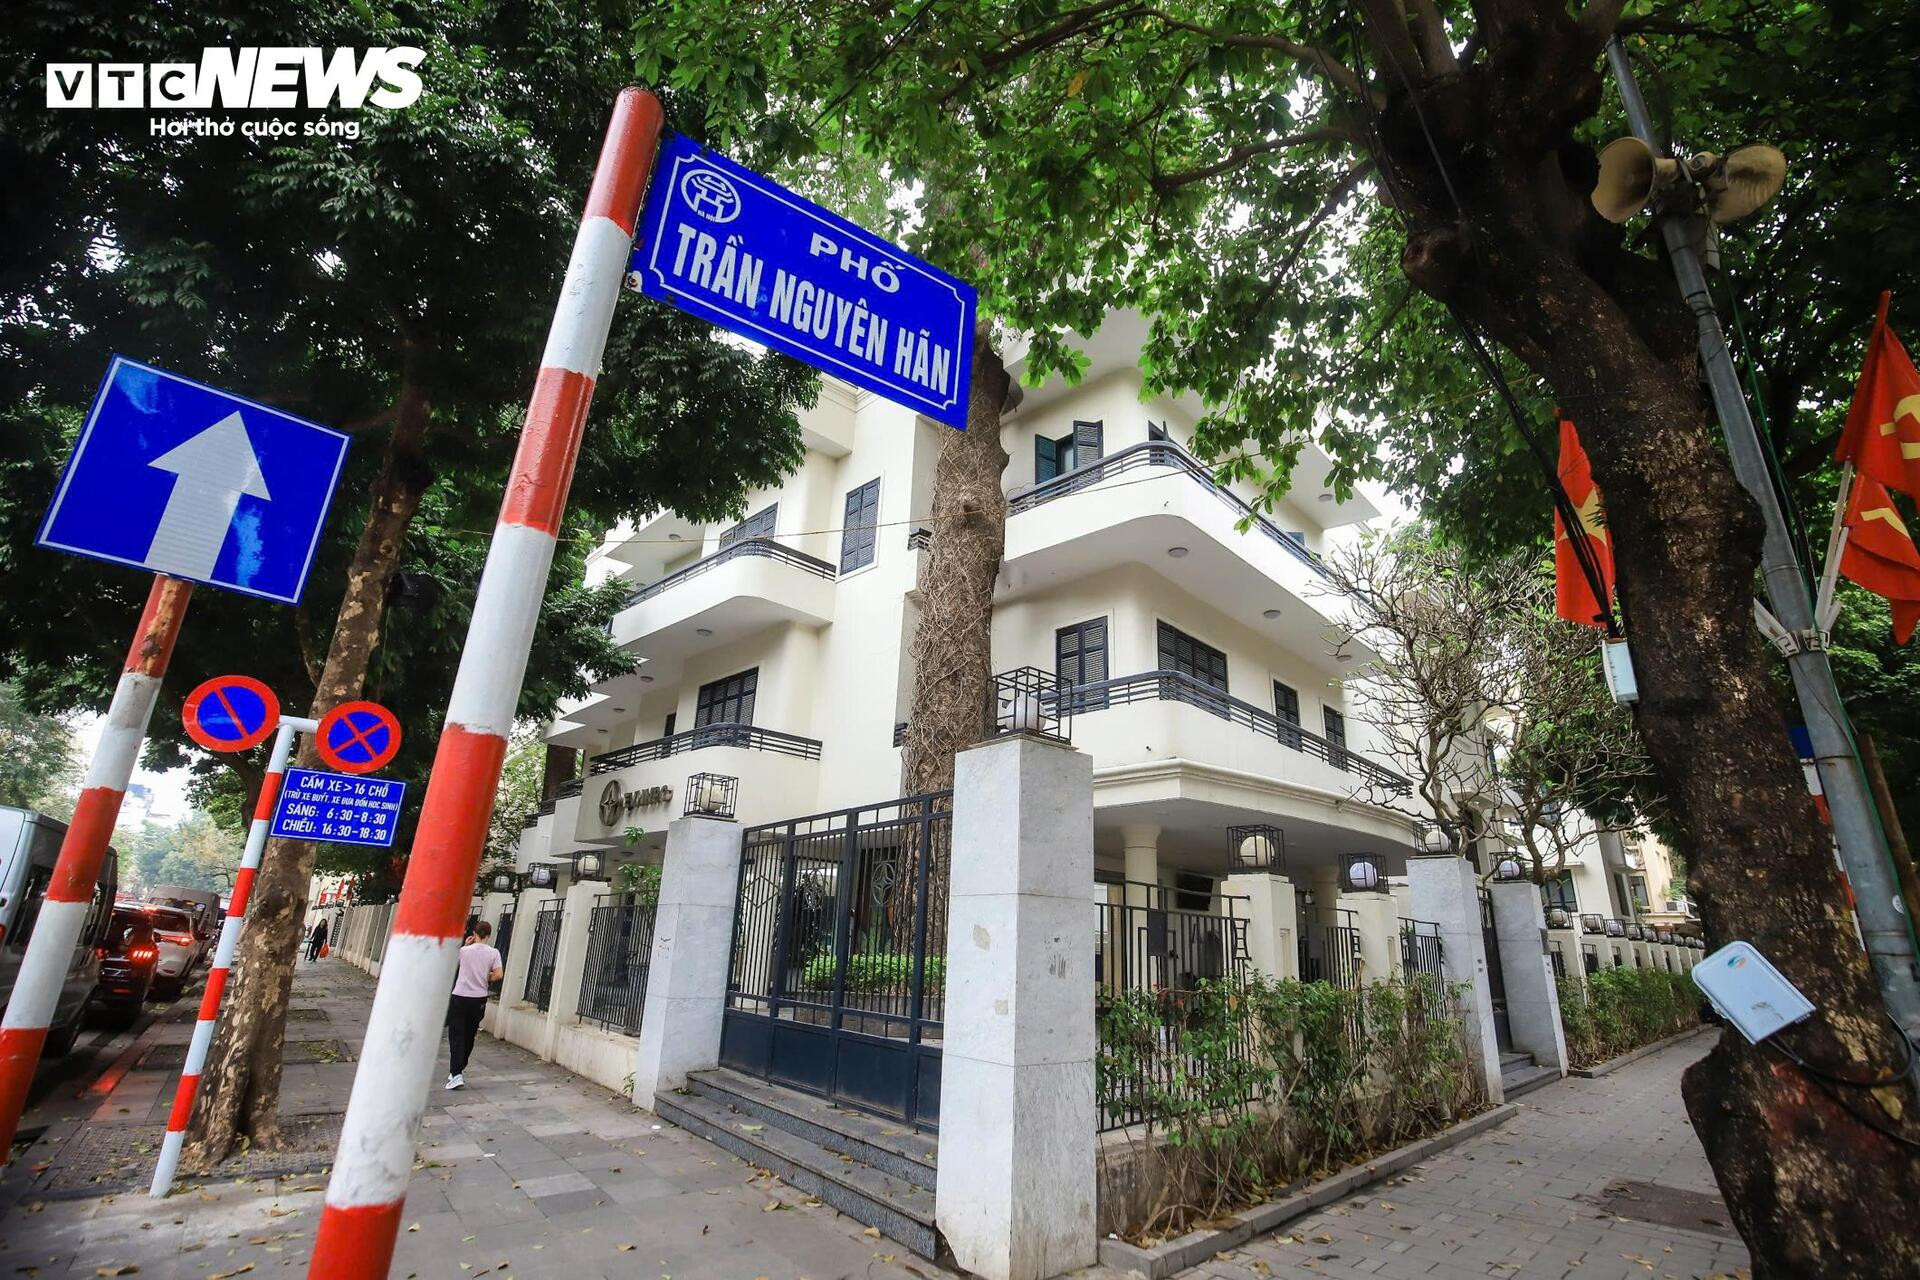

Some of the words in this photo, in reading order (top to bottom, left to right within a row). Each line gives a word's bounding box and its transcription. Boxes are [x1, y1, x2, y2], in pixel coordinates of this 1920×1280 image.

[810, 233, 904, 293] PHỐ
[672, 223, 764, 309] TRẦN
[769, 269, 888, 367] NGUYÊN
[893, 329, 950, 396] HÃN
[300, 774, 324, 790] CẤM
[327, 780, 343, 792] XE
[343, 783, 352, 791] >
[354, 783, 366, 795] 16
[368, 783, 389, 798] CHỖ
[301, 792, 311, 801] XE
[331, 796, 341, 804] XE
[286, 801, 320, 817] SÁNG:
[282, 817, 317, 833] CHIỀU:
